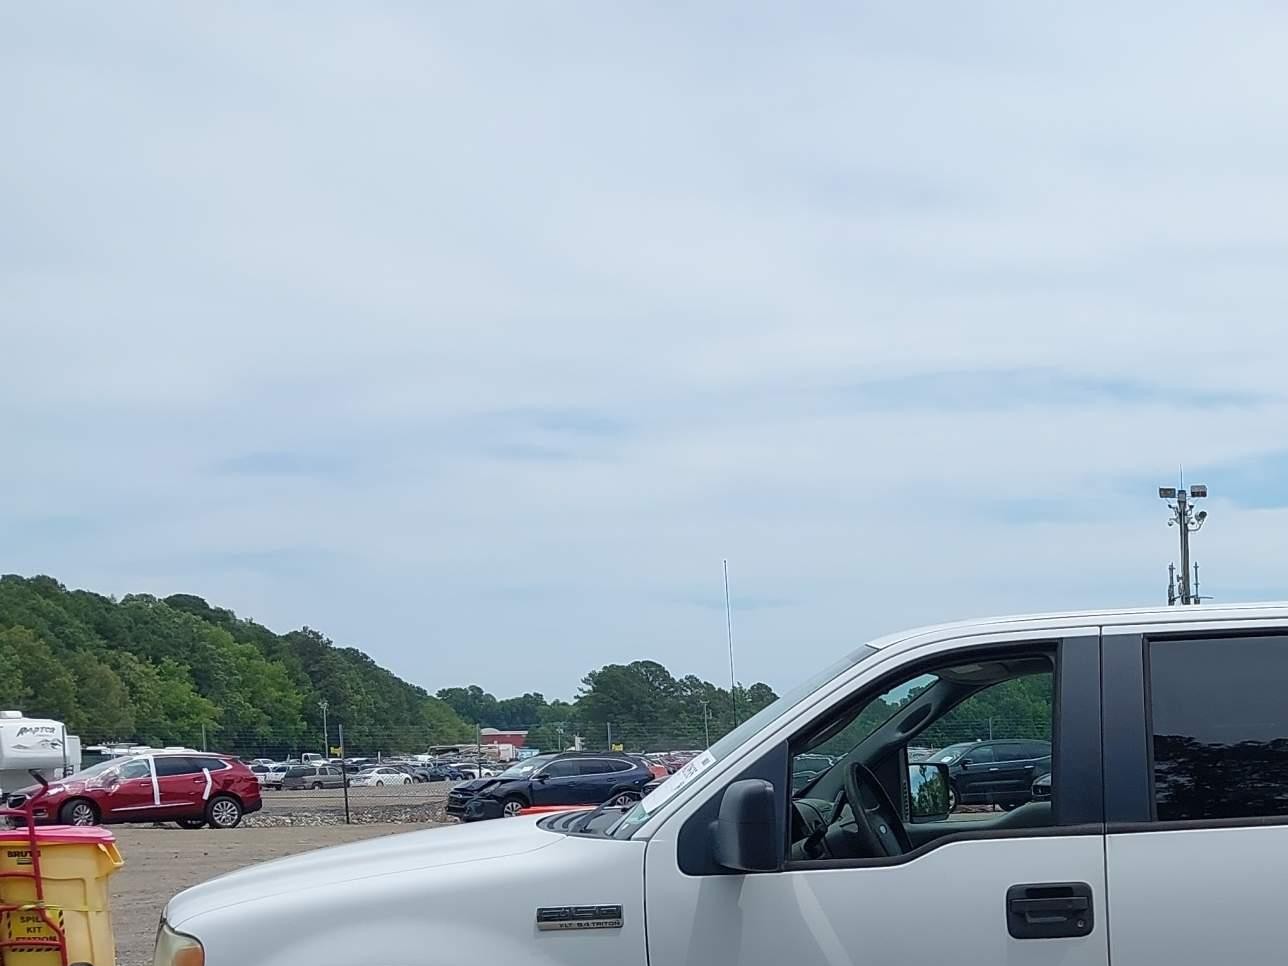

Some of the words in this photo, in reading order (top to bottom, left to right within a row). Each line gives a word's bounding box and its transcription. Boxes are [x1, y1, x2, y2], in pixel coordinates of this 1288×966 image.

[16, 726, 56, 737] RAPTOR
[20, 915, 42, 923] SPIL
[26, 926, 42, 934] KIT
